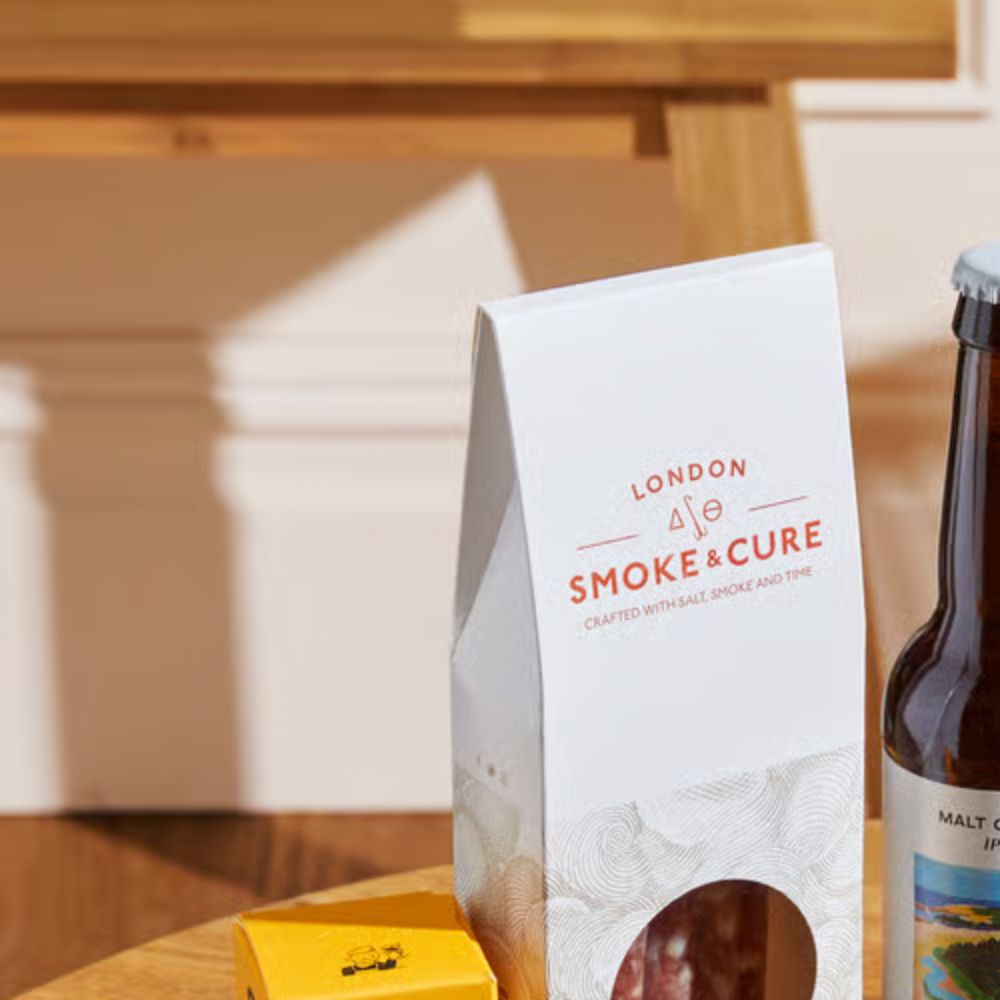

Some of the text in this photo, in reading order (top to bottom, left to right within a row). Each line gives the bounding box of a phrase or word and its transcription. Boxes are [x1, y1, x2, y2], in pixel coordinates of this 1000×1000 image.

[631, 458, 747, 500] LONDON
[568, 519, 823, 605] SMOKE & CURE
[584, 606, 641, 630] CRAFTED
[643, 597, 677, 617] WITH
[710, 579, 753, 601] SMOKE
[755, 573, 783, 590] AND
[784, 566, 813, 585] TIME
[938, 810, 986, 830] MALT
